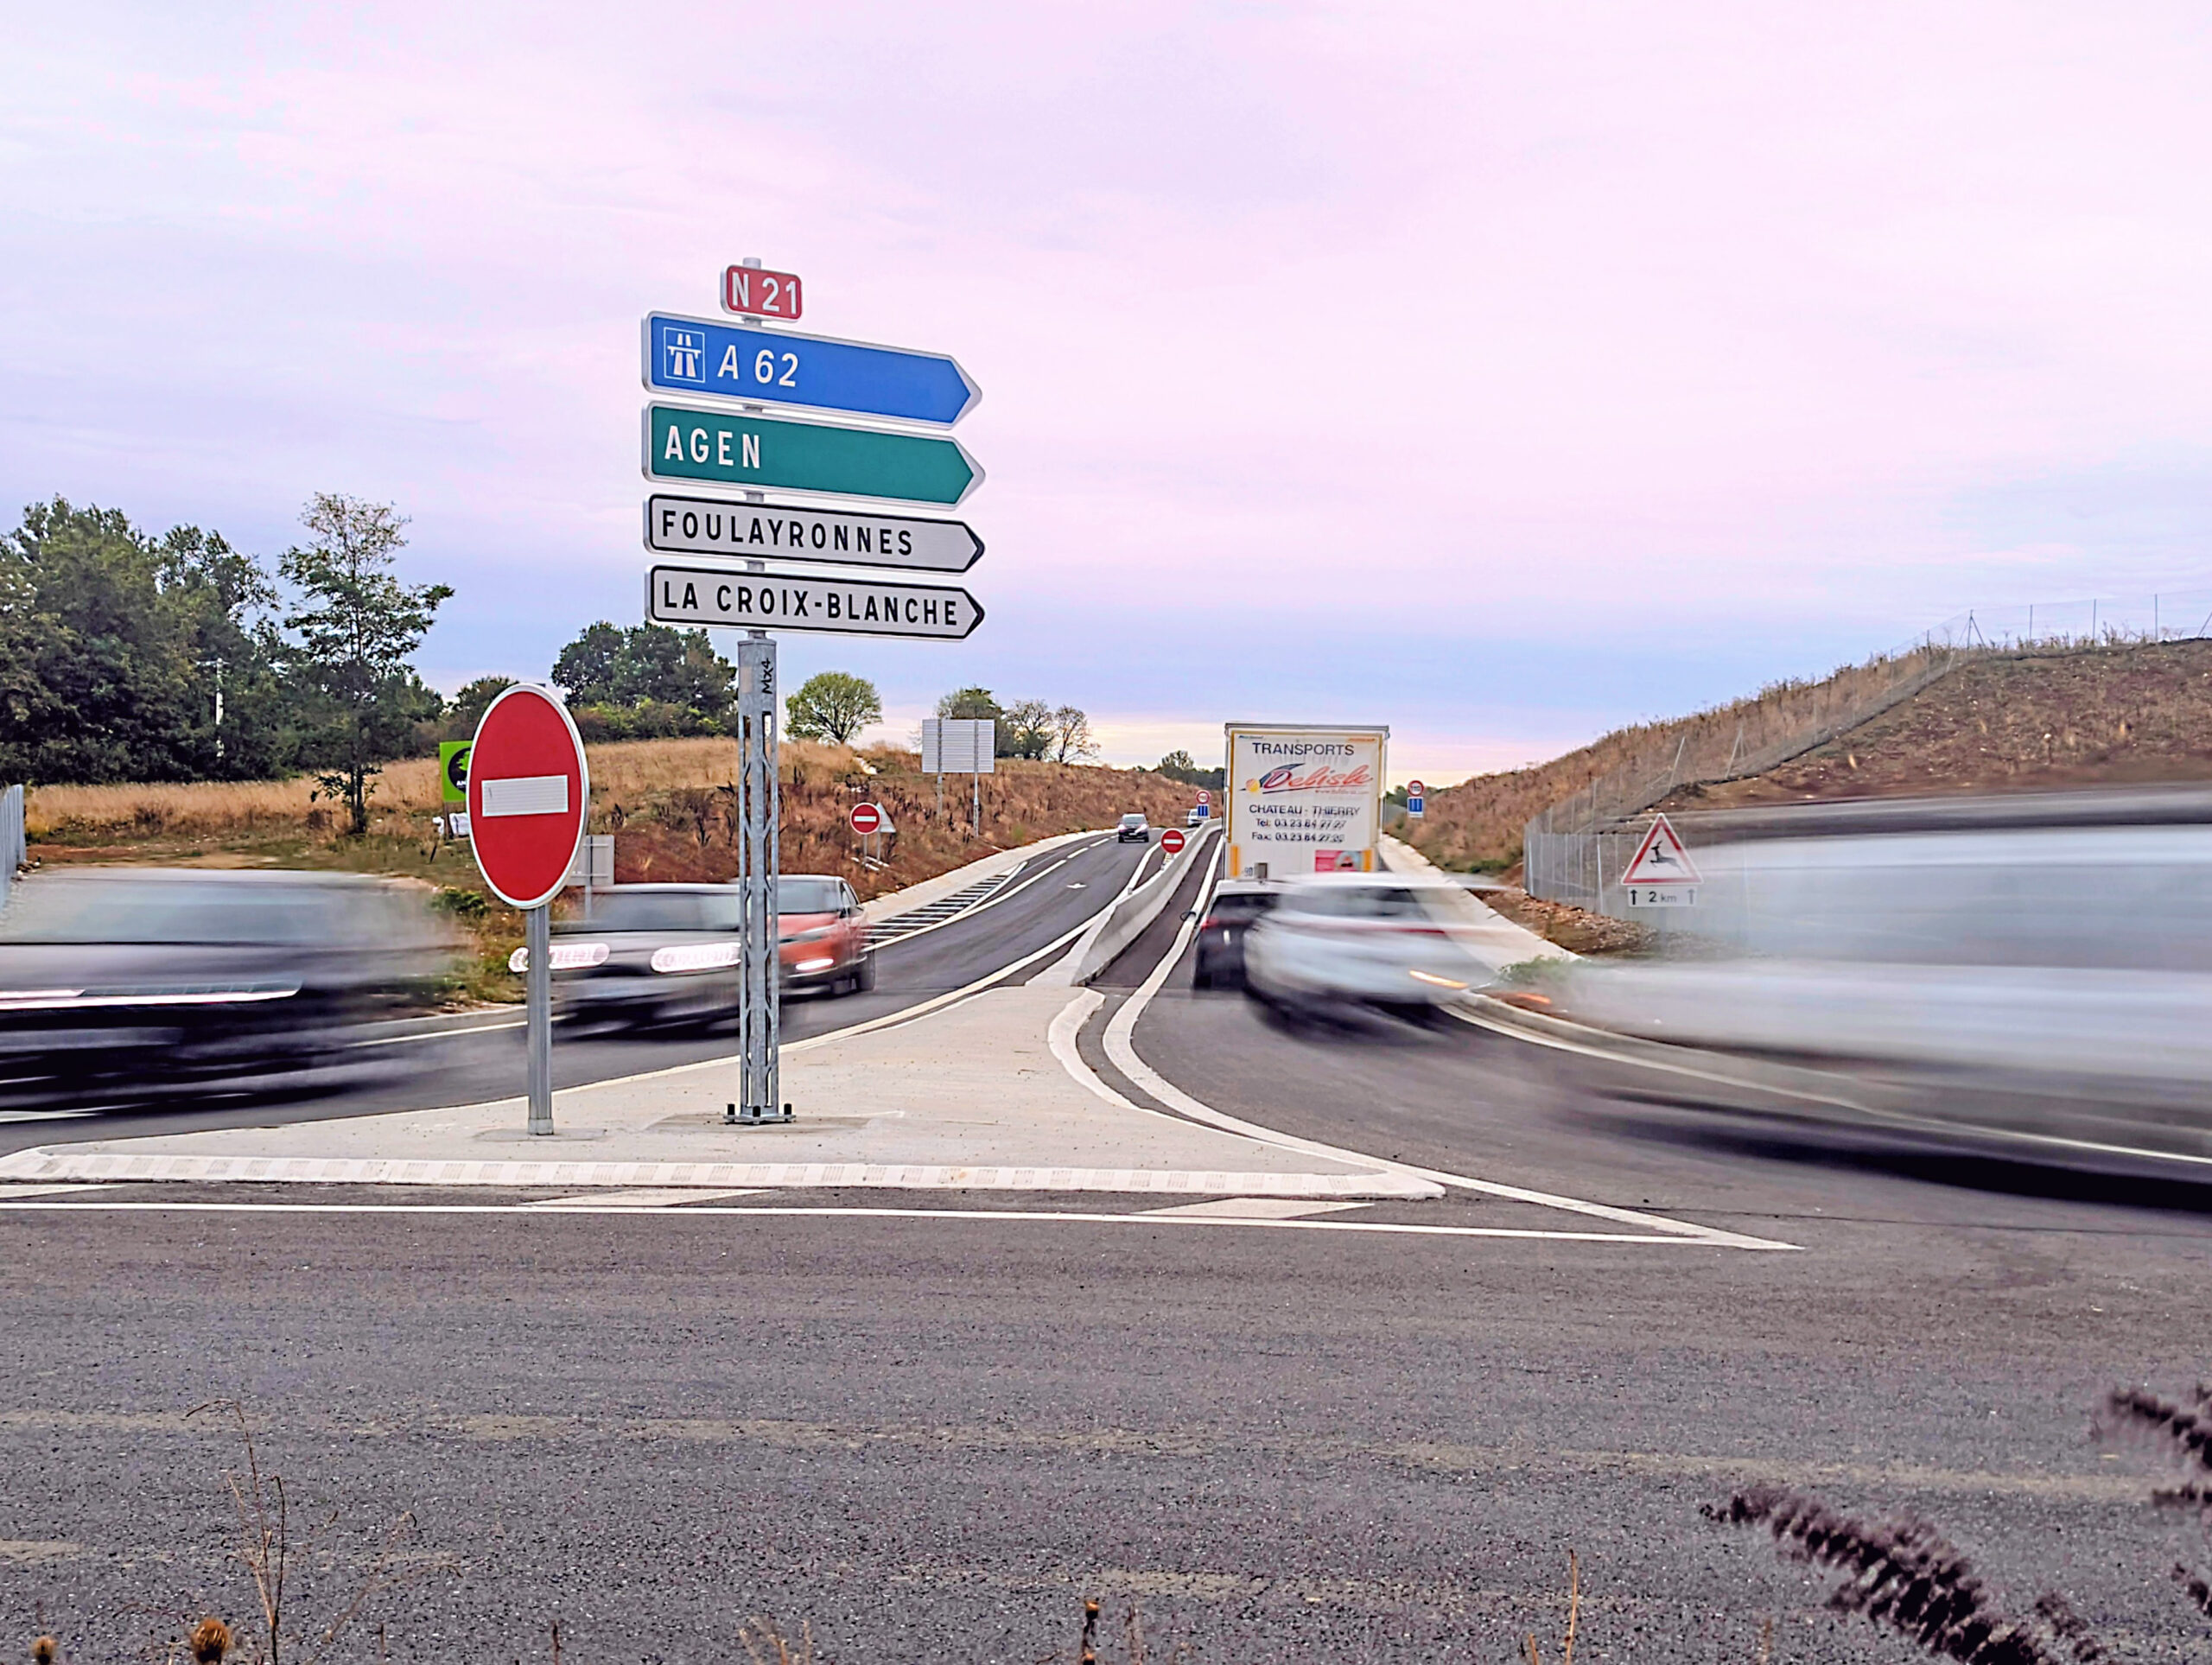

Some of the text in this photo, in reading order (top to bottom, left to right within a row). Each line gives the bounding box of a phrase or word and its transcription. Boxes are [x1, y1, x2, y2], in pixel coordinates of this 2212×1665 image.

[731, 271, 798, 315] N 21
[717, 345, 799, 387] A 62
[664, 425, 760, 468] AGEN
[662, 510, 912, 556] FOULAYRONNES
[664, 581, 957, 626] LA CROIX-BLANCHE
[1252, 742, 1354, 755] TRANSPORTS
[1249, 804, 1302, 814] CHATEAU
[1649, 891, 1676, 903] 2 km
